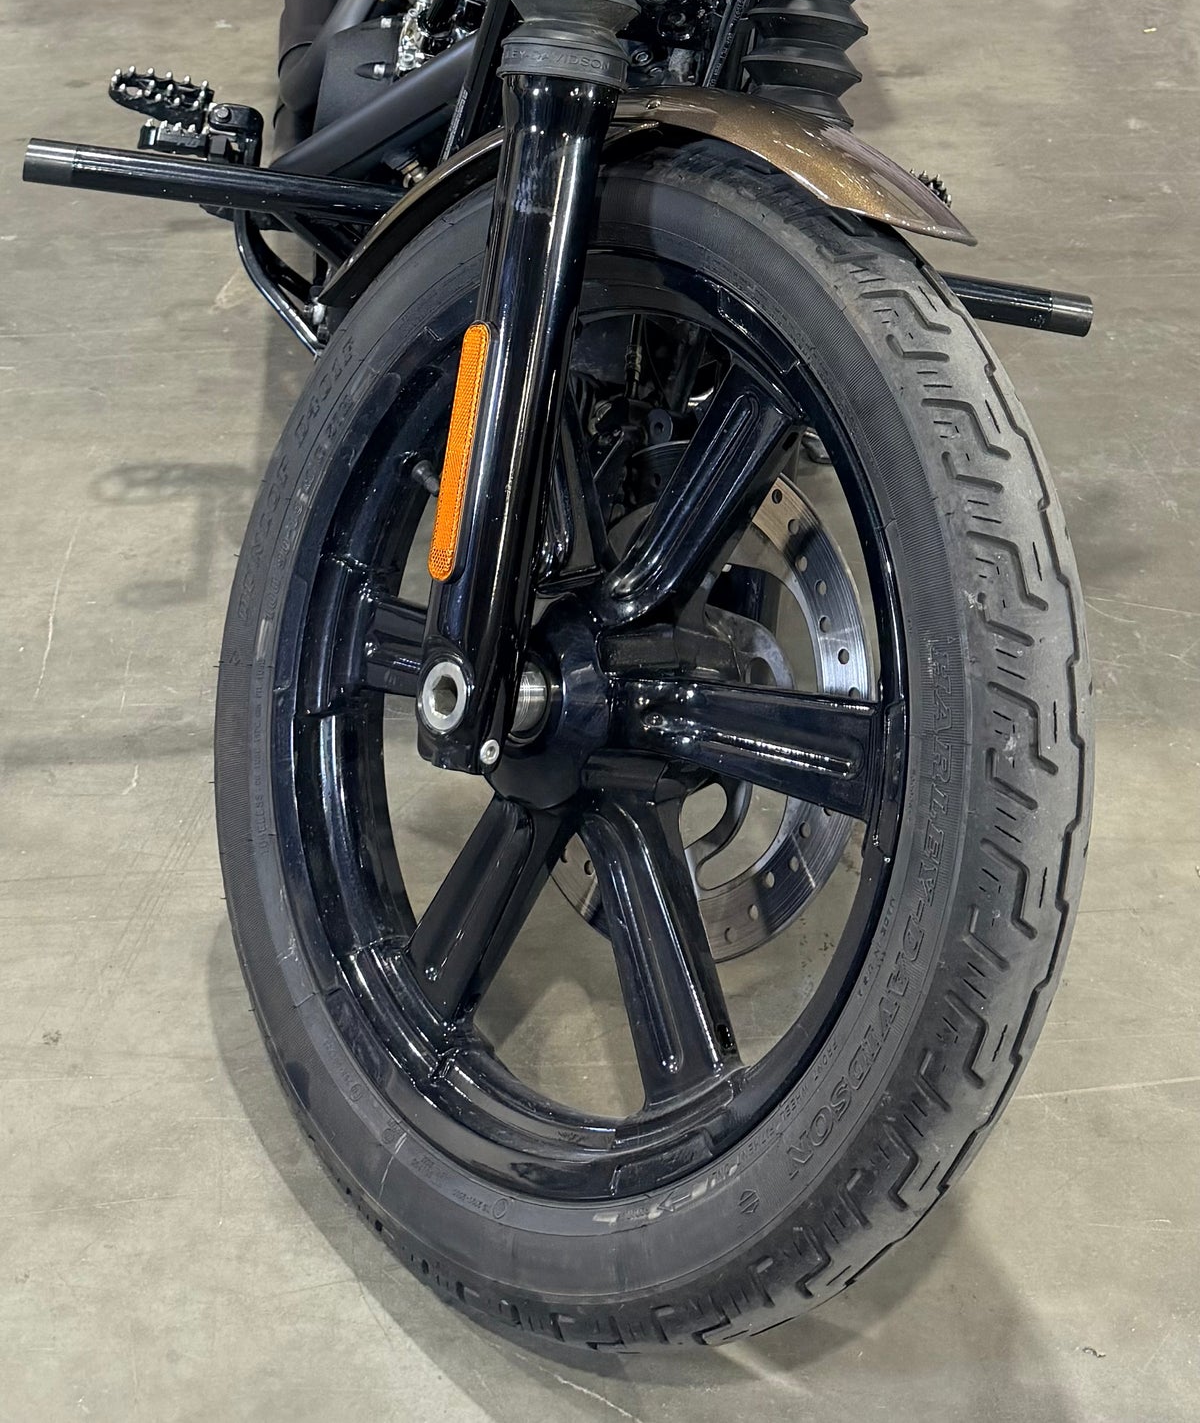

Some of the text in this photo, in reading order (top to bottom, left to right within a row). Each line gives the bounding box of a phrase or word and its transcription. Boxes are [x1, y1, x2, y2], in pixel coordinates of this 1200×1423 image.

[787, 642, 952, 1180] HARLEY-DAVIDSON
[813, 1038, 838, 1081] FRONT
[780, 1084, 809, 1122] WHEEL
